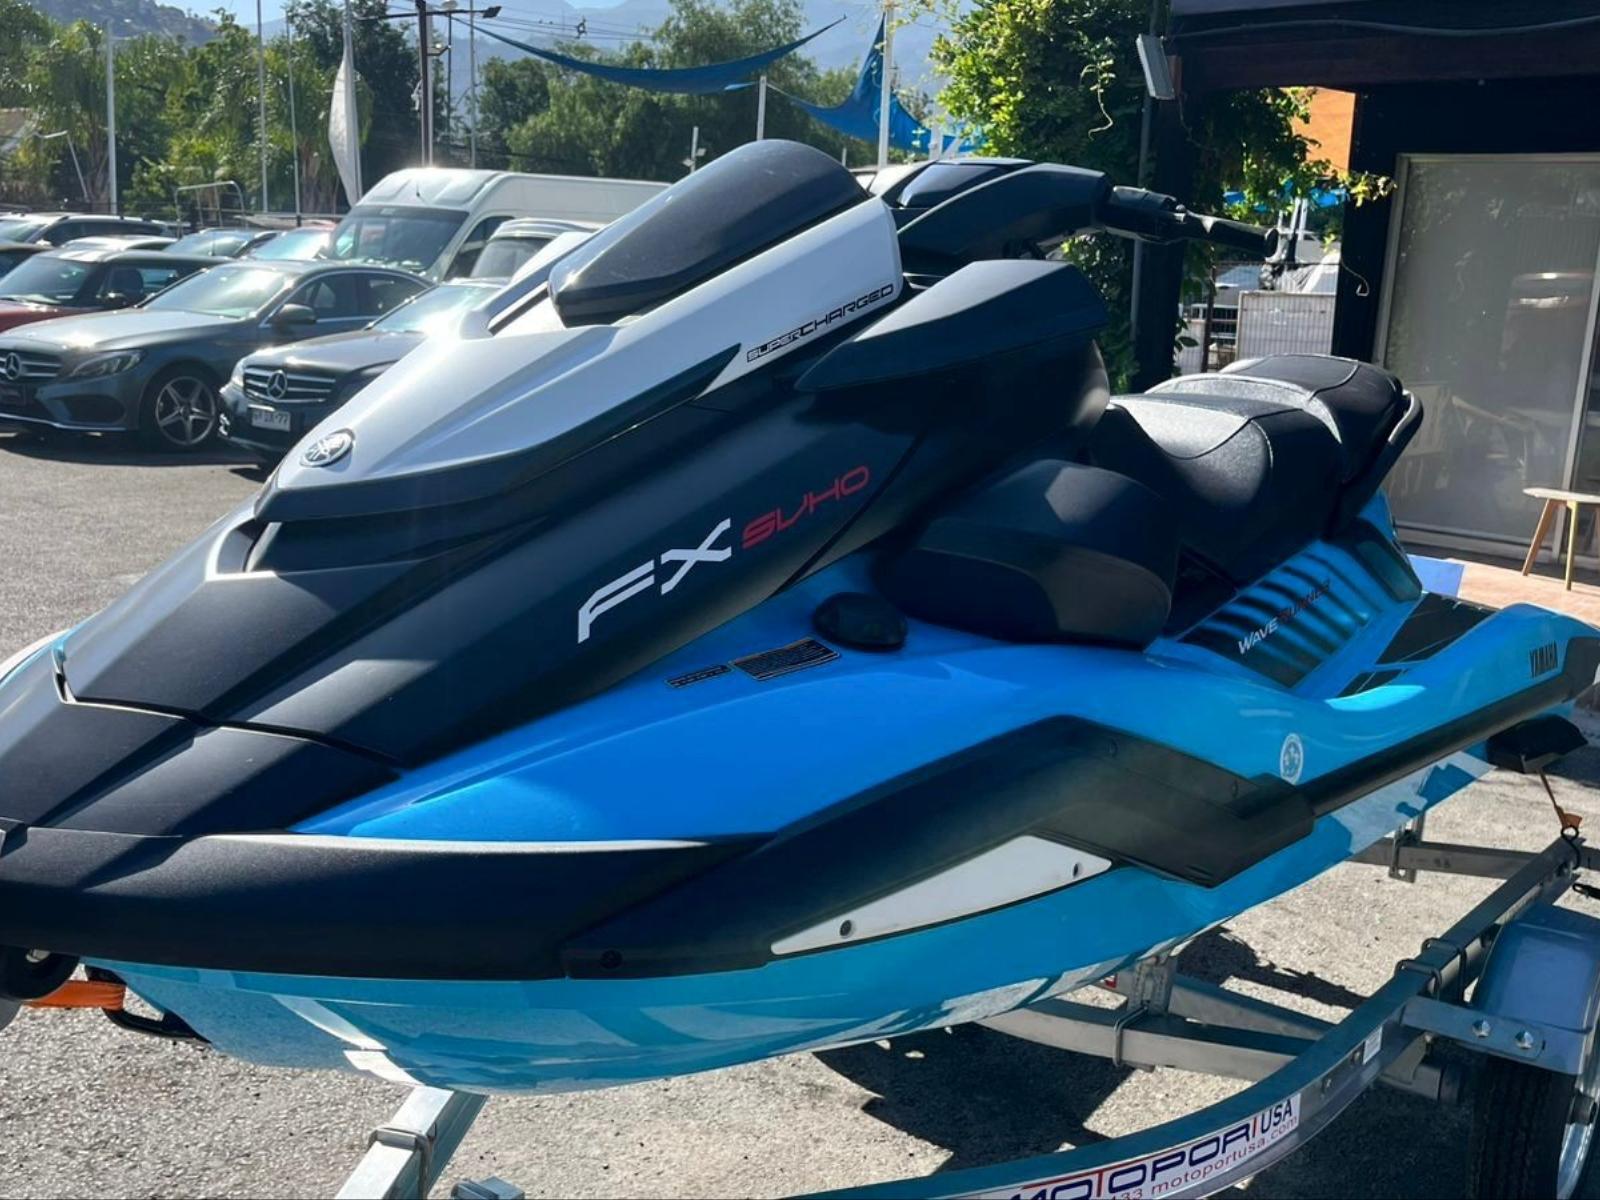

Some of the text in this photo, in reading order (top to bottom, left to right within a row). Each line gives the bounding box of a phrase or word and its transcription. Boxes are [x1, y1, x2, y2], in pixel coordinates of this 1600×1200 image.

[747, 283, 895, 363] SUPERCHARGED
[577, 517, 732, 644] FX
[1151, 1115, 1298, 1195] motoportusa.com
[1261, 1099, 1293, 1135] USA
